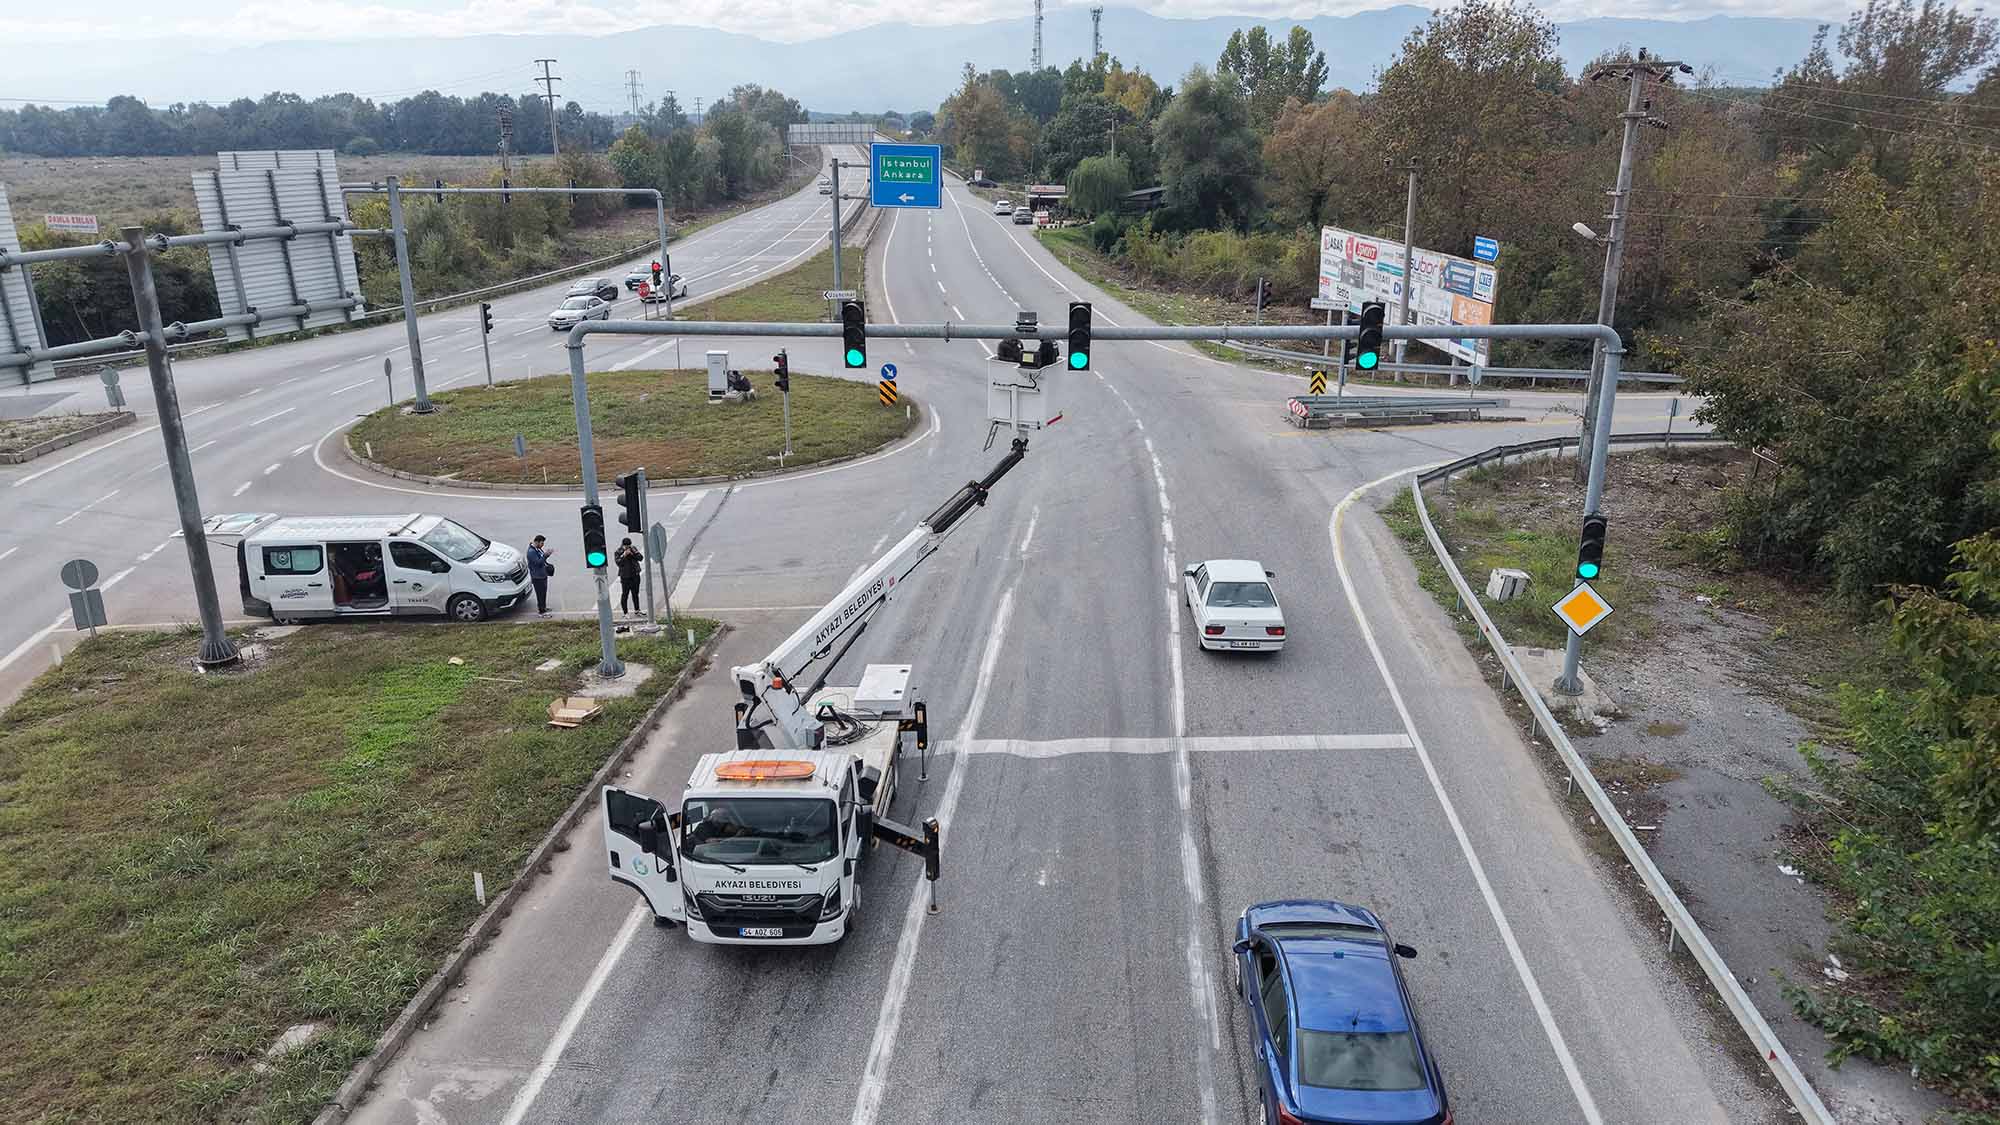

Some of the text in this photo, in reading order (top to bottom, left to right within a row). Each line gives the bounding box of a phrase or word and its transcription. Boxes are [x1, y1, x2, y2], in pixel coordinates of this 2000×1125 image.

[883, 171, 923, 179] Ankara
[816, 615, 843, 645] AKYAZI
[715, 880, 747, 889] AKYAZI
[742, 894, 776, 902] ISUZU
